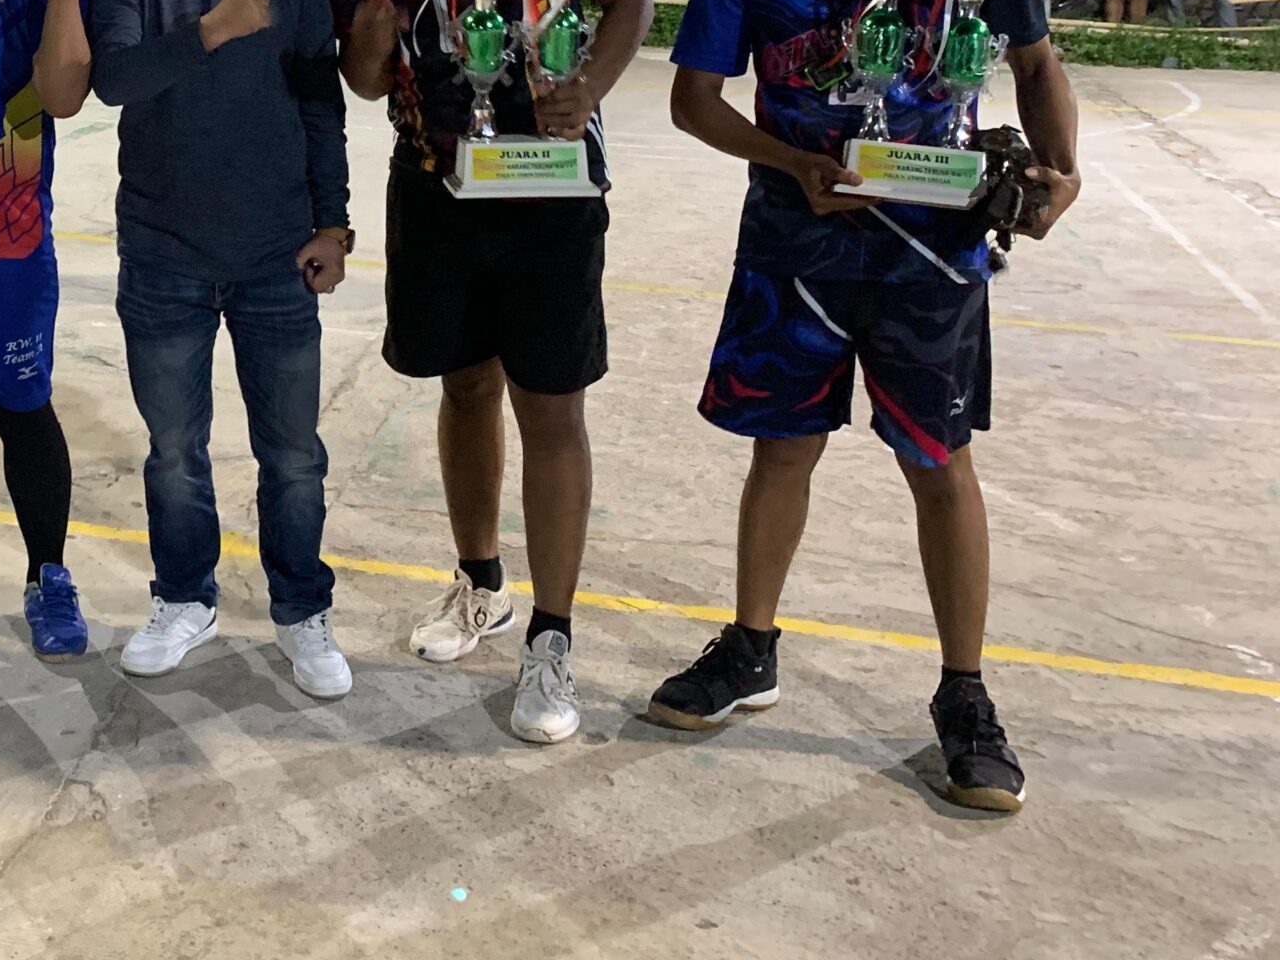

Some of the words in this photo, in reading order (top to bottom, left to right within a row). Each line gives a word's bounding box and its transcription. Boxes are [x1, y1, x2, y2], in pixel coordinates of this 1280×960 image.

[499, 151, 539, 159] JUARA
[542, 150, 550, 159] II
[886, 150, 932, 163] JUARA
[934, 154, 949, 165] III
[3, 350, 35, 365] Team
